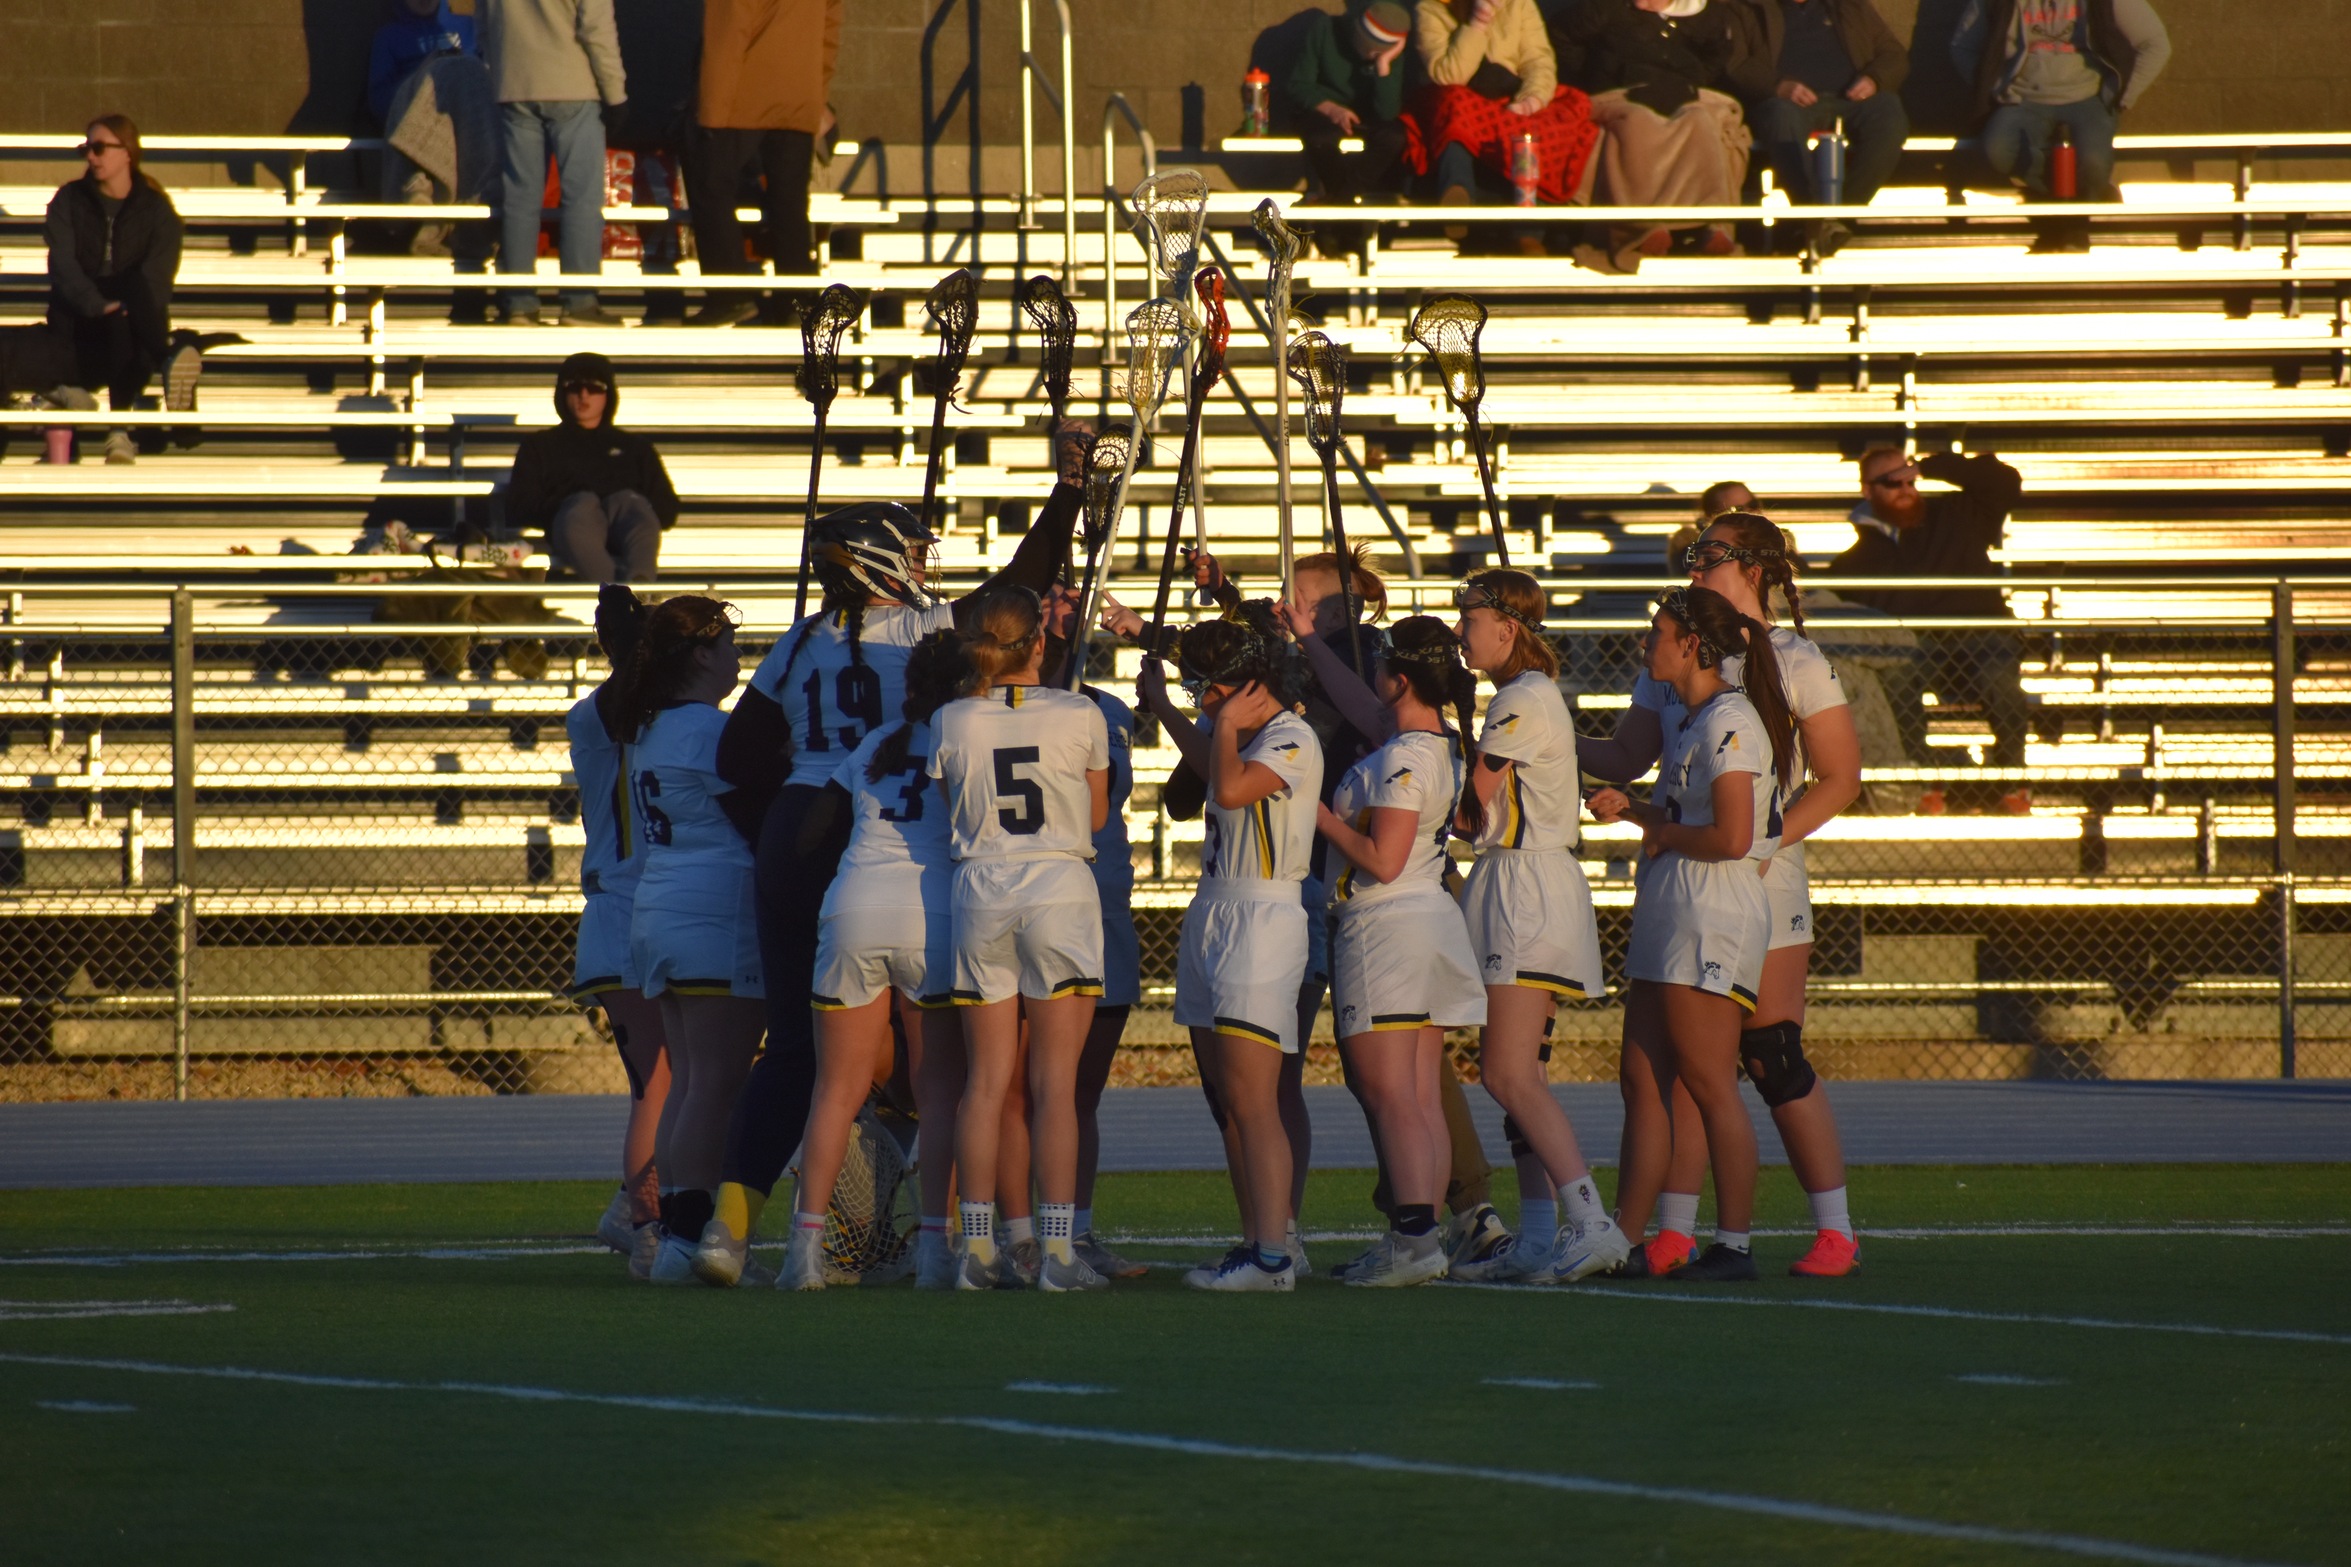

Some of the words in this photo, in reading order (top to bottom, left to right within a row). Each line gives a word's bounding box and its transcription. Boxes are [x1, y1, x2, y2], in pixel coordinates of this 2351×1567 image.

[1176, 485, 1187, 513] GAIT
[1760, 549, 1781, 557] STX
[1503, 605, 1525, 620] STX
[803, 665, 883, 753] 19
[879, 755, 932, 823] 3
[993, 745, 1046, 836] 5
